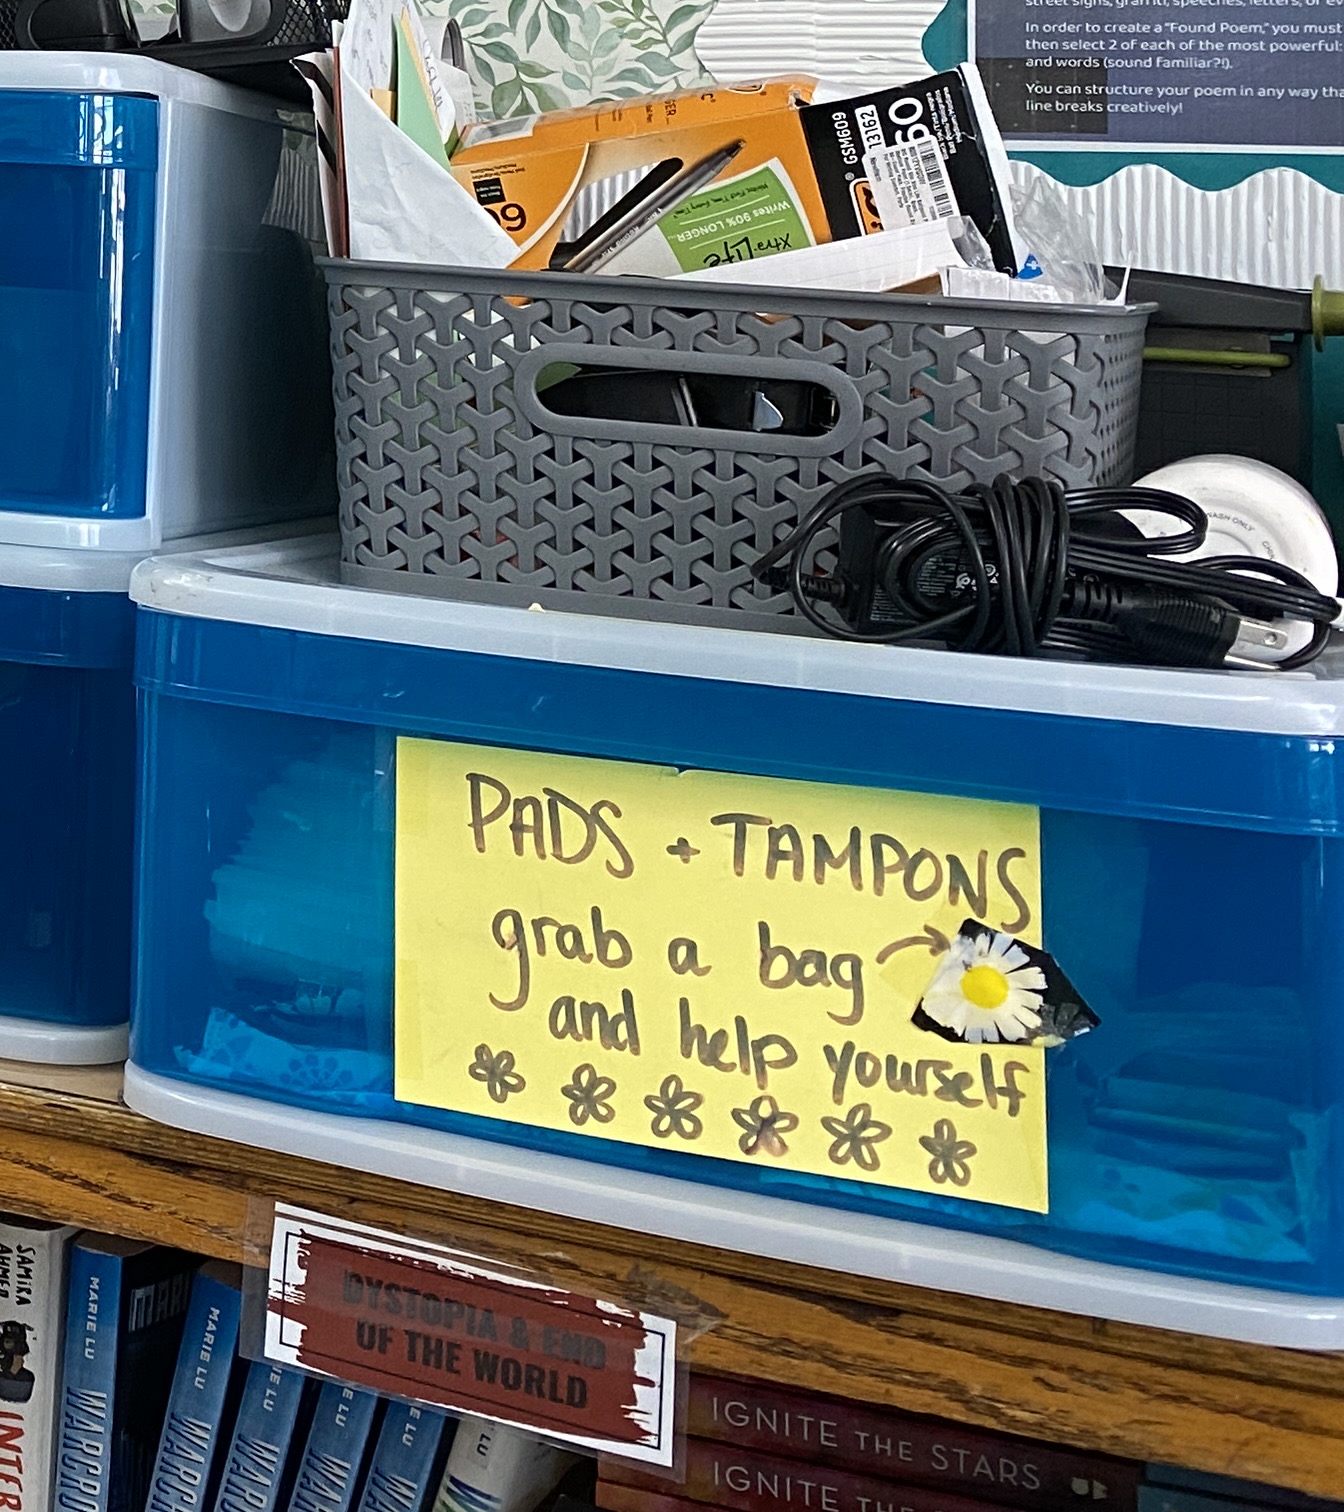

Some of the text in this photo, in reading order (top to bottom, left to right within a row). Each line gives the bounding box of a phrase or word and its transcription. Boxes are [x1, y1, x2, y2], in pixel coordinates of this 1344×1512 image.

[831, 111, 858, 165] GSM609
[862, 110, 882, 149] 13162
[1026, 100, 1183, 115] line breaks creatively!
[466, 772, 1032, 935] PADS + TAMPONS
[489, 905, 865, 1026] grab a bag
[549, 988, 1030, 1118] and help yourself
[342, 1269, 607, 1370] DYSTOPIA & END
[355, 1317, 589, 1409] OF THE WORLD
[712, 1396, 1041, 1492] IGNITE THE STARS
